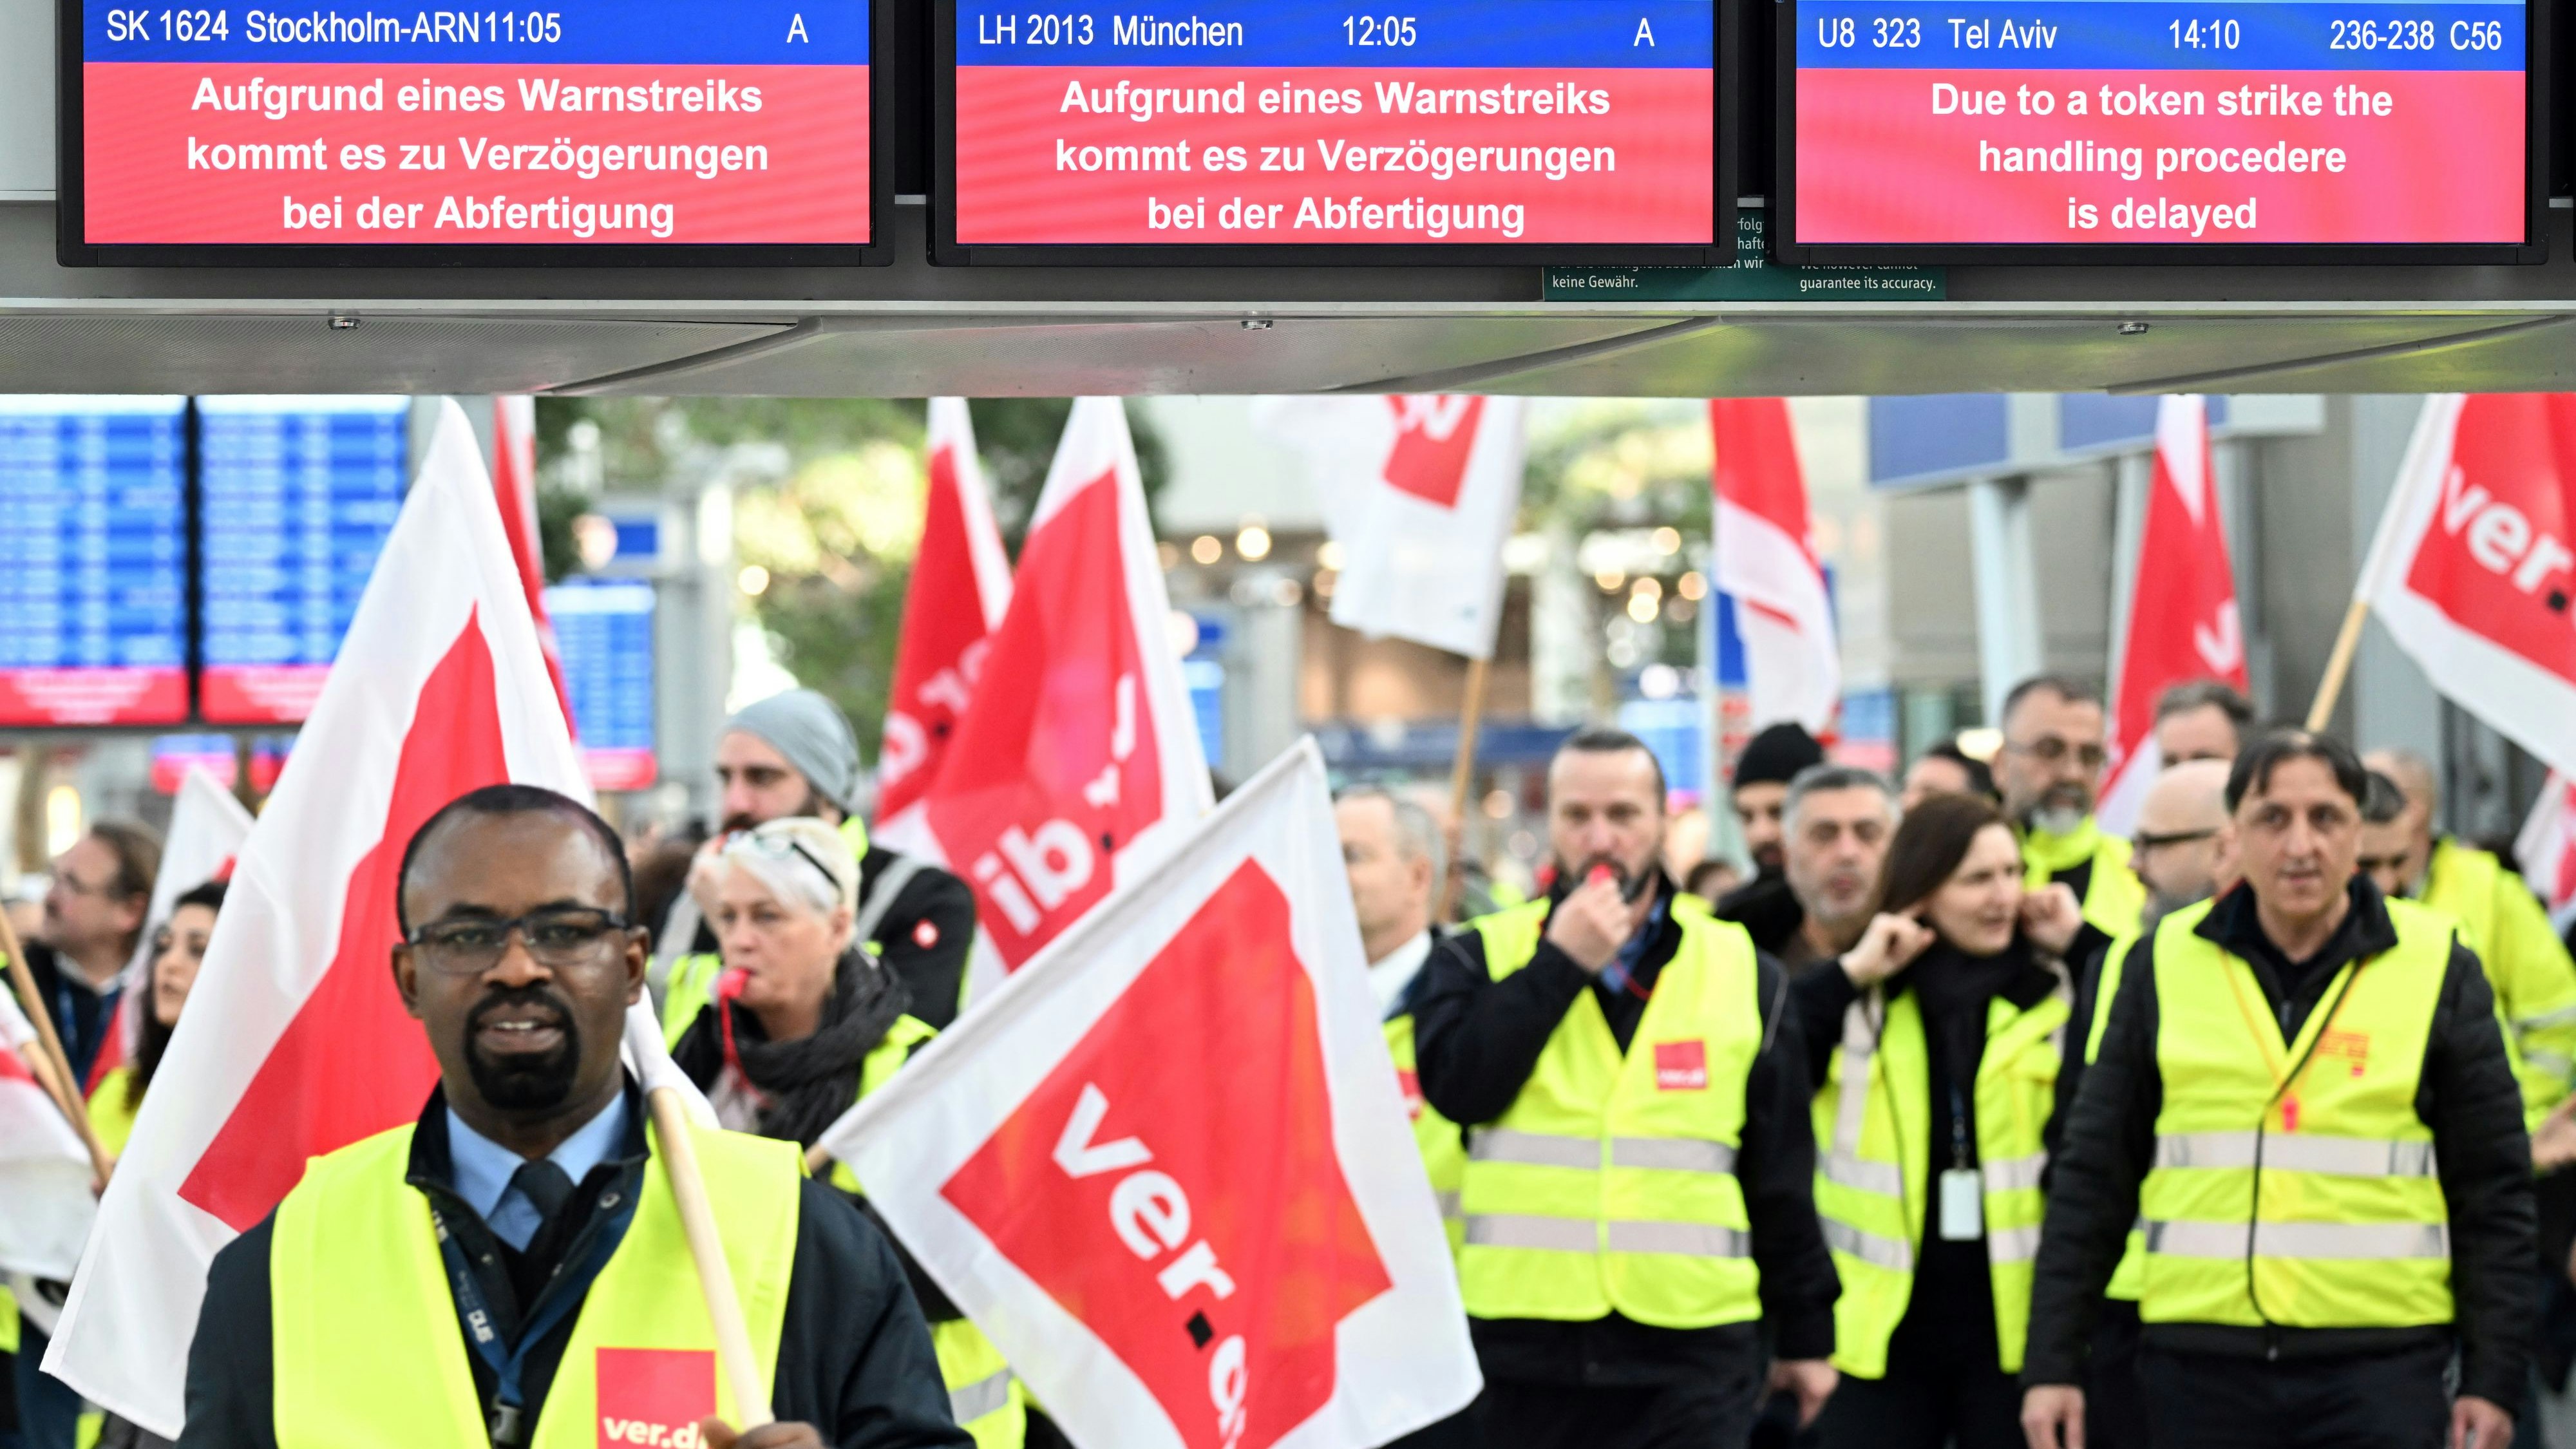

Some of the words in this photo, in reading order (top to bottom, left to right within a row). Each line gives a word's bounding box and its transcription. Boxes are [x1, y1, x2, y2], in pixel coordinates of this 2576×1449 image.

[107, 9, 150, 41] SK
[160, 9, 229, 42] 1624
[246, 10, 480, 43] Stockholm-ARN
[484, 11, 561, 43] 11:05
[786, 13, 809, 43] A
[980, 14, 1016, 44] LH
[1027, 14, 1094, 45] 2013
[1113, 15, 1243, 46] München
[1343, 15, 1416, 46] 12:05
[1633, 17, 1655, 47] A
[1819, 17, 1855, 48] U8
[1872, 17, 1921, 48] 323
[1947, 18, 1989, 49] Tel
[1998, 19, 2058, 49] Aviv
[2169, 19, 2240, 50] 14:10
[2329, 19, 2435, 50] 236-238
[2450, 20, 2502, 51] C56
[191, 77, 383, 120] Aufgrund
[397, 78, 506, 111] eines
[517, 79, 762, 112] Warnstreiks
[1060, 80, 1245, 122] Aufgrund
[1258, 81, 1363, 114] eines
[1374, 81, 1610, 115] Warnstreiks
[1932, 83, 2006, 115] Due
[2017, 84, 2055, 115] to
[2067, 90, 2088, 115] a
[2099, 84, 2204, 116] token
[2217, 84, 2322, 116] strike
[2333, 84, 2392, 117] the
[188, 137, 328, 170] kommt
[339, 144, 386, 170] es
[399, 145, 445, 171] zu
[458, 137, 768, 180] Verzögerungen
[1057, 138, 1191, 171] kommt
[1203, 146, 1247, 171] es
[1260, 147, 1304, 172] zu
[1317, 139, 1615, 180] Verzögerungen
[1980, 140, 2142, 181] handling
[2156, 140, 2346, 180] procedere
[283, 196, 342, 229] bei
[356, 196, 424, 229] der
[434, 195, 674, 238] Abfertigung
[1148, 196, 1205, 229] bei
[1218, 196, 1283, 229] der
[1293, 196, 1524, 238] Abfertigung
[2069, 197, 2099, 229] is
[2111, 197, 2257, 238] delayed
[1553, 275, 1585, 288] keine
[1589, 275, 1638, 288] Gewähr.
[1800, 277, 1861, 292] guarantee
[1864, 276, 1879, 289] its
[1882, 279, 1936, 292] accuracy.
